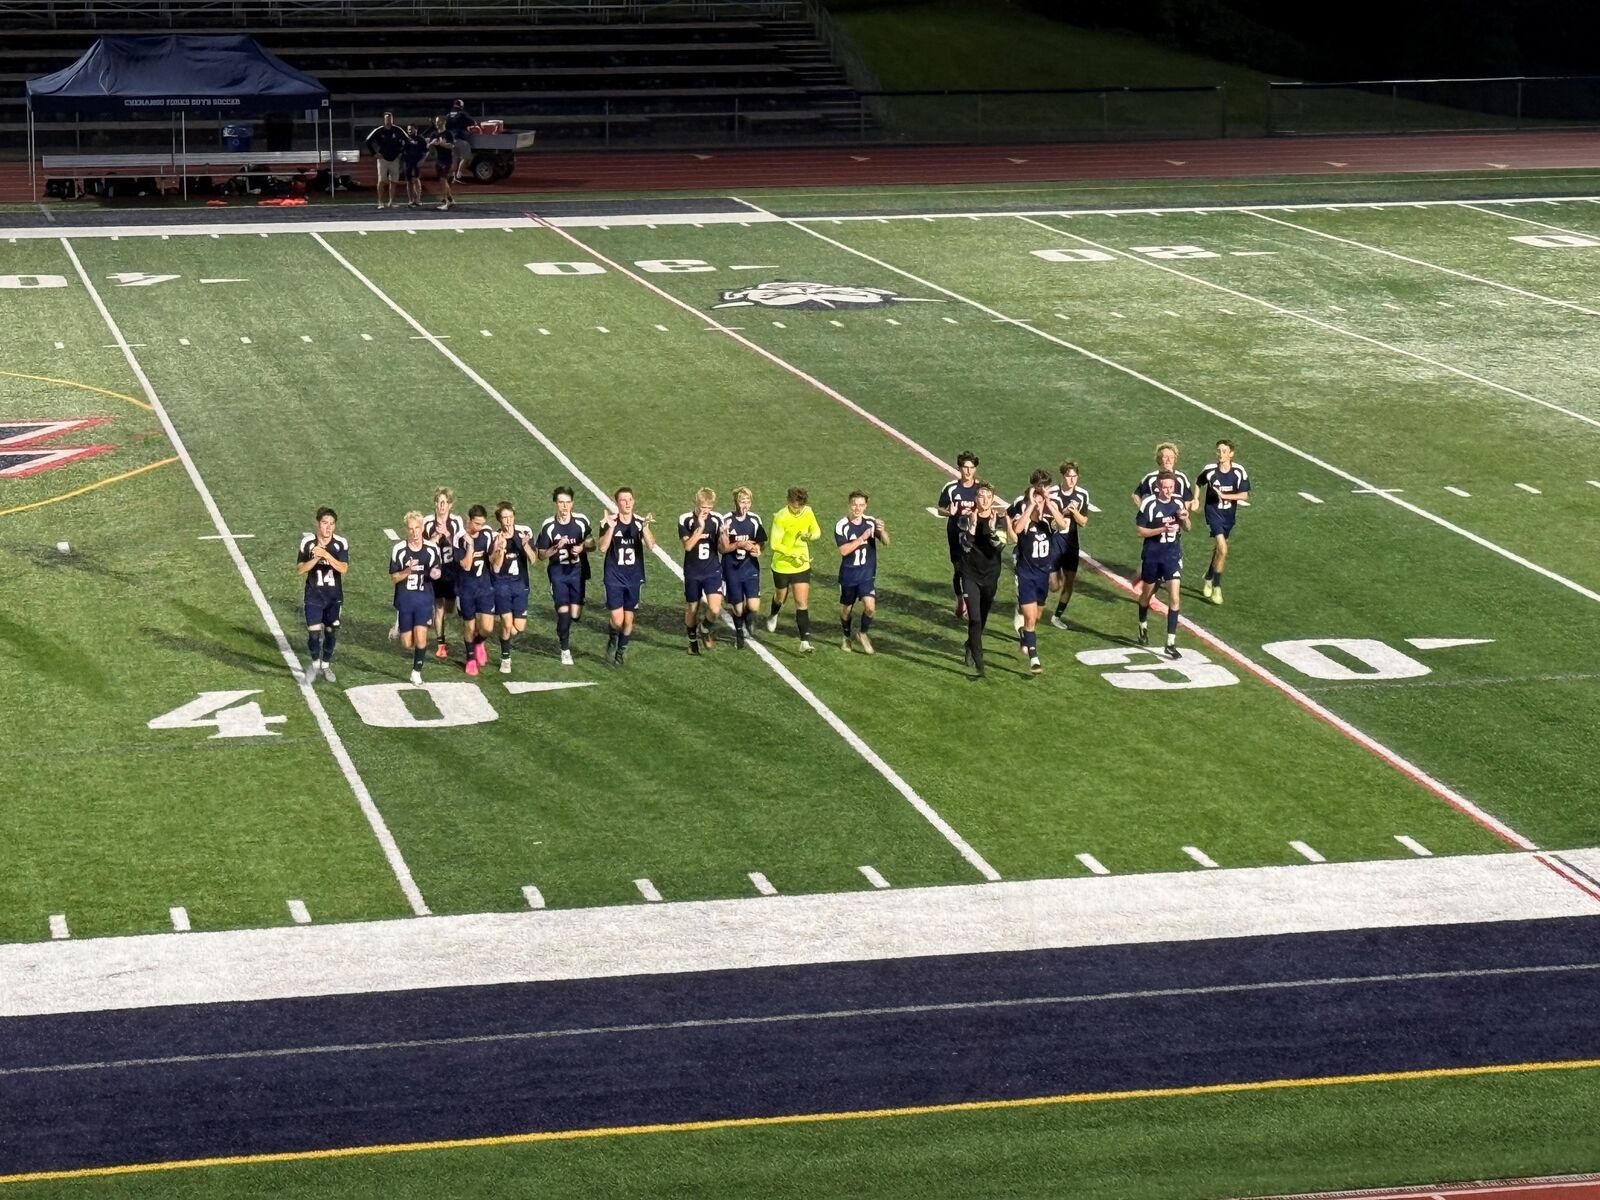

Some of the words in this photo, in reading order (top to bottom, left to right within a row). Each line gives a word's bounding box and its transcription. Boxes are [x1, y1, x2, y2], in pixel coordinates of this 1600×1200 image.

[617, 547, 636, 566] 13
[698, 543, 710, 560] 6
[853, 547, 867, 566] 11
[1032, 540, 1050, 558] 10
[316, 569, 336, 587] 14
